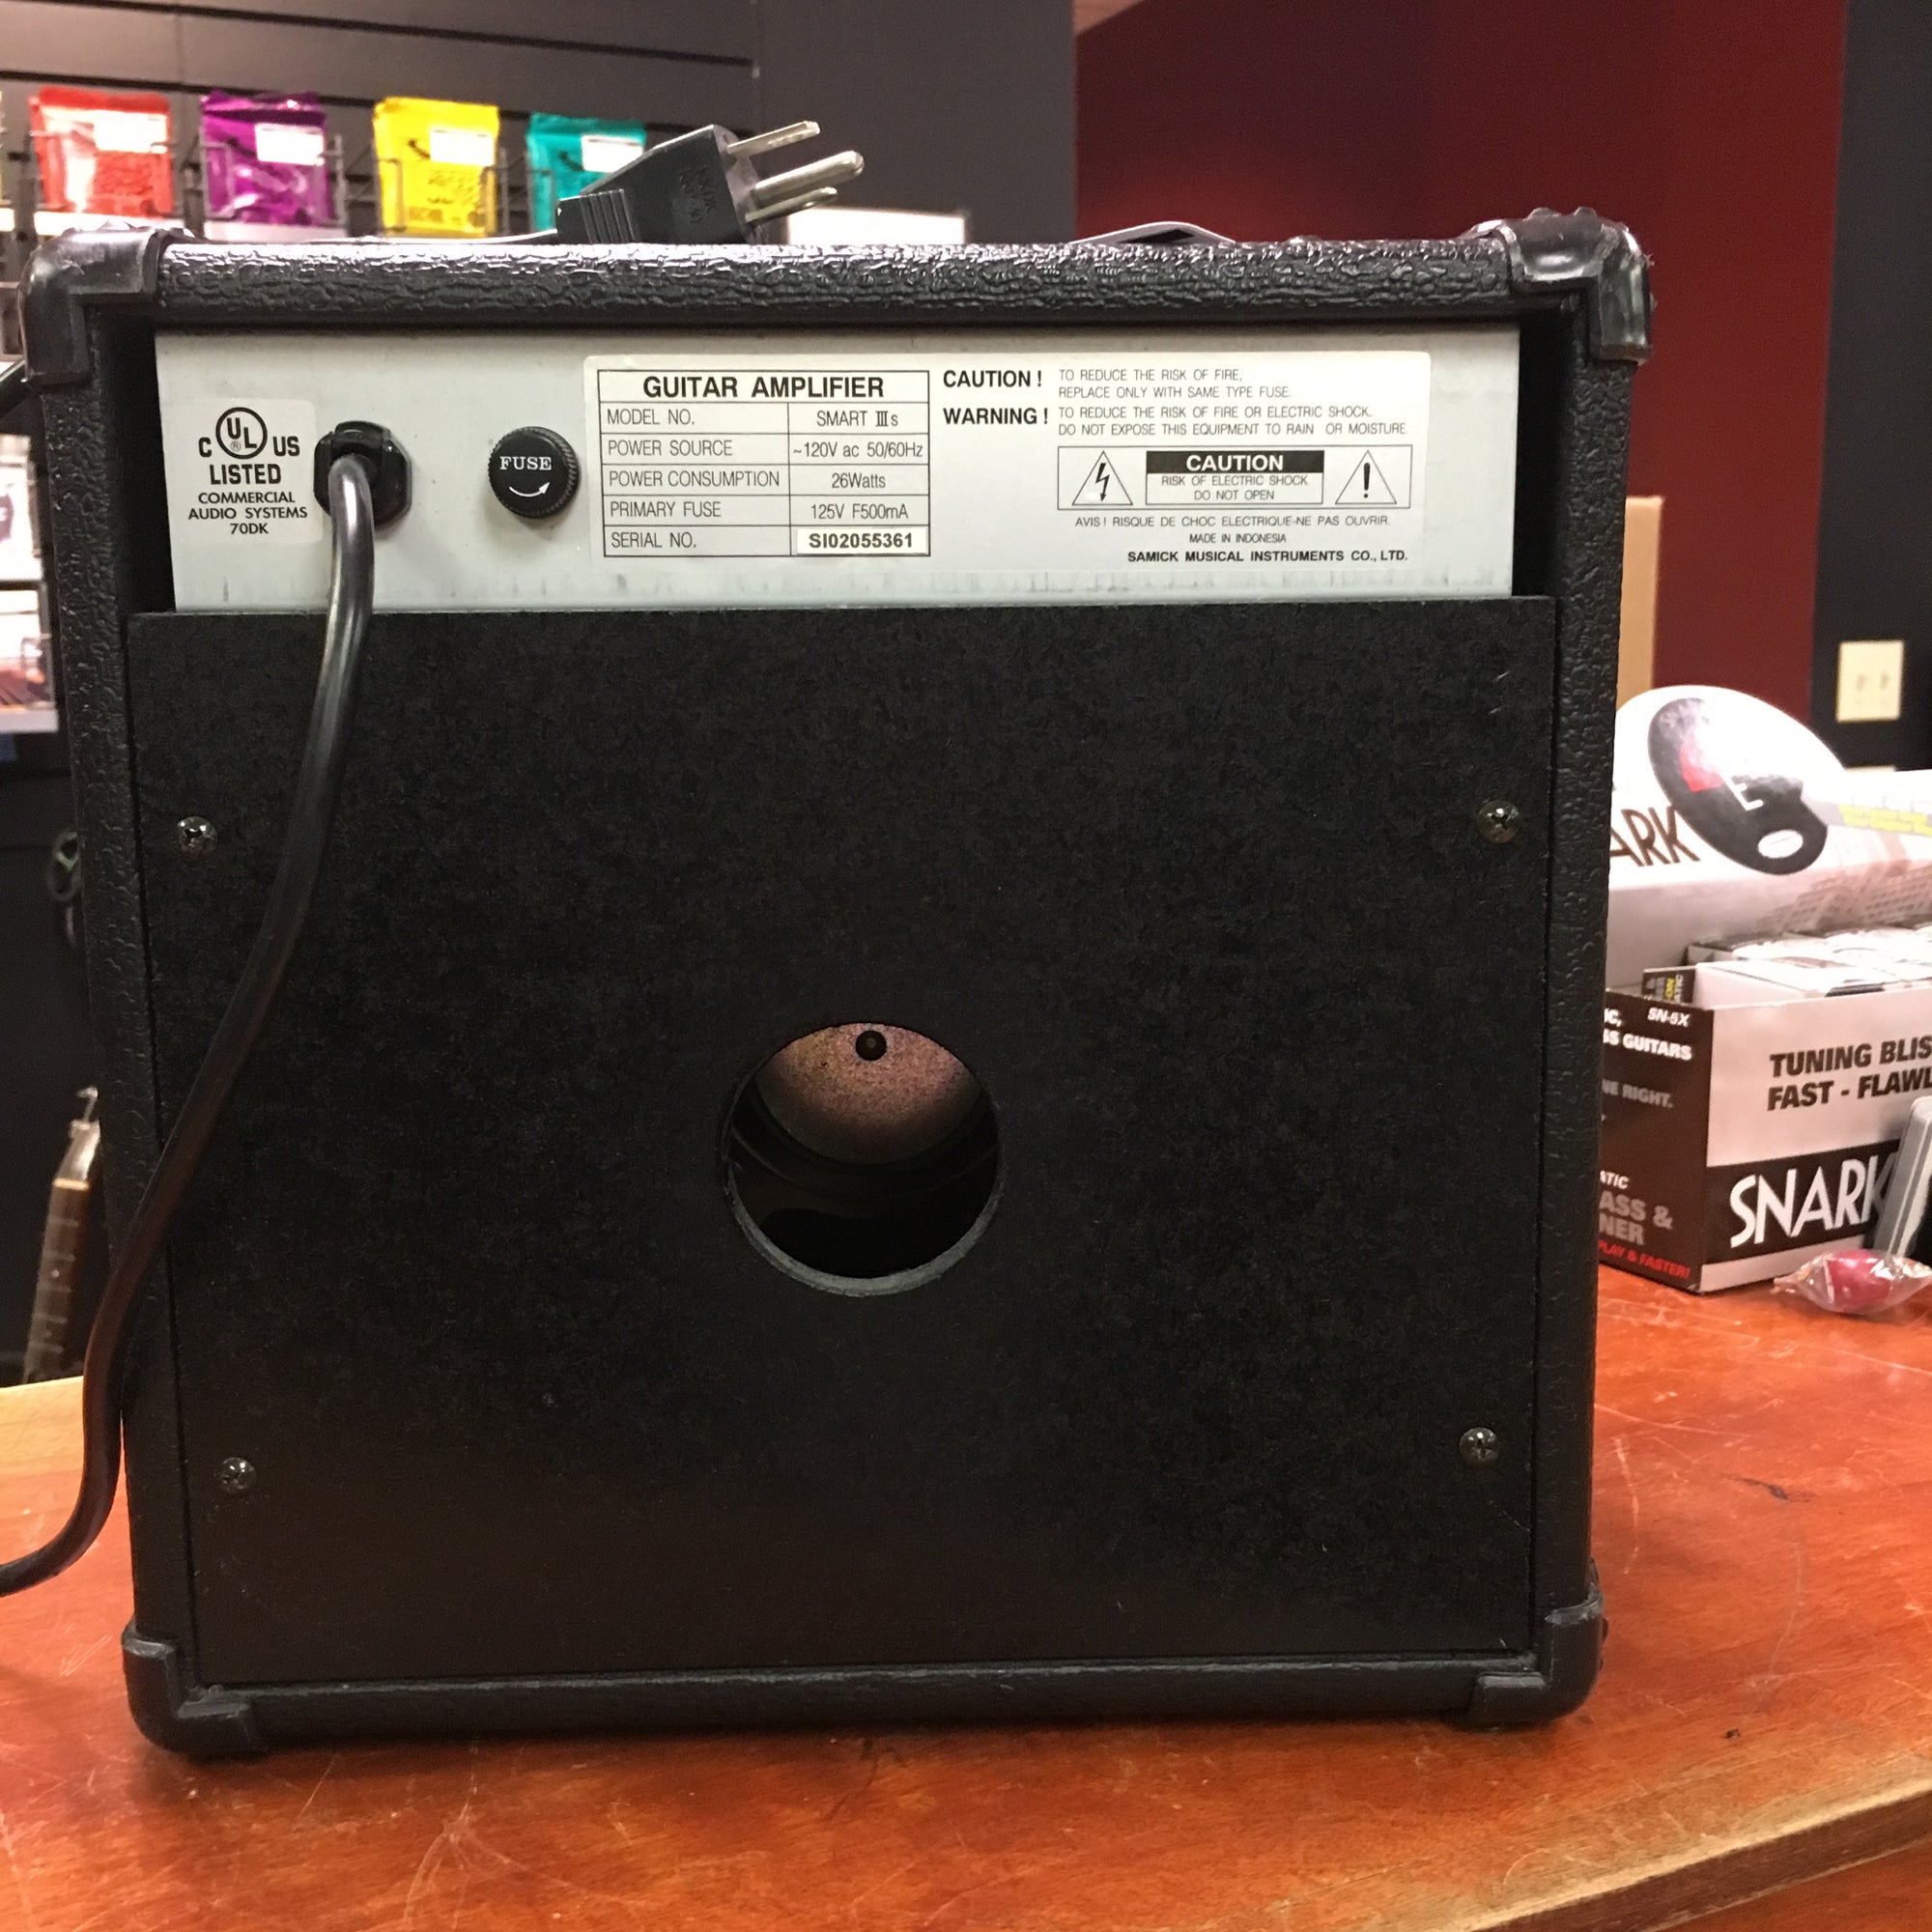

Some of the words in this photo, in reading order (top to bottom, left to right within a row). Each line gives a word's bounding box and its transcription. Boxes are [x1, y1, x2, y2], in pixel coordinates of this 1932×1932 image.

[944, 370, 1031, 387] CAUTION
[1060, 369, 1074, 381] TO
[1081, 369, 1126, 381] REDUCE
[1134, 369, 1154, 381] THE
[1162, 369, 1186, 381] RISK
[1193, 369, 1208, 381] OF
[643, 376, 737, 398] GUITAR
[752, 377, 883, 397] AMPLIFIER
[1059, 386, 1110, 398] REPLACE
[1117, 386, 1148, 398] ONLY
[1153, 386, 1181, 397] WITH
[1188, 386, 1219, 398] SAME
[1226, 386, 1252, 398] TYPE
[1260, 386, 1291, 398] FUSE.
[608, 409, 660, 425] MODEL
[668, 409, 695, 425] NO.
[817, 411, 867, 426] SMART
[943, 408, 1037, 424] WARNING
[1059, 407, 1074, 418] TO
[1080, 407, 1126, 418] REDUCE
[1133, 407, 1154, 418] THE
[1161, 407, 1186, 418] RISK
[1193, 407, 1208, 418] OF
[1214, 406, 1238, 418] FIRE
[1244, 406, 1262, 418] OR
[1267, 406, 1321, 418] ELECTRIC
[1329, 406, 1372, 417] SHOCK.
[1059, 424, 1076, 436] DO
[1082, 424, 1105, 436] NOT
[1112, 424, 1155, 436] EXPOSE
[1162, 423, 1186, 436] THIS
[1193, 423, 1259, 435] EQUIPMENT
[1265, 423, 1281, 435] TO
[1287, 423, 1314, 435] RAIN
[1325, 422, 1342, 435] OR
[1349, 422, 1408, 435] MOISTURE.
[199, 438, 212, 457] C
[272, 436, 299, 456] US
[609, 440, 662, 456] POWER
[669, 440, 732, 456] SOURCE
[843, 445, 859, 457] ac
[867, 441, 923, 459] 50/60Hz
[499, 456, 553, 470] FUSE
[1186, 455, 1284, 471] CAUTION
[210, 464, 281, 485] LISTED
[610, 470, 663, 487] POWER
[668, 470, 779, 487] CONSUMPTION
[832, 472, 886, 488] 26Watts
[1161, 475, 1185, 486] RISK
[1191, 475, 1207, 486] OF
[1211, 475, 1264, 486] ELECTRIC
[1269, 475, 1308, 486] SHOCK
[198, 492, 295, 504] COMMERCIAL
[1194, 490, 1210, 500] DO
[1216, 490, 1238, 500] NOT
[1244, 490, 1274, 500] OPEN
[188, 507, 237, 520] AUDIO
[245, 507, 307, 519] SYSTEMS
[611, 501, 675, 517] PRIMARY
[683, 501, 721, 518] FUSE
[811, 503, 844, 519] 125V
[853, 503, 908, 519] F500mA
[230, 523, 269, 534] 70DK
[1113, 517, 1153, 526] RISQUE
[1160, 517, 1175, 526] DE
[1181, 516, 1215, 526] CHOC
[1318, 516, 1339, 526] PAS
[611, 532, 663, 548] SERIAL
[670, 532, 697, 548] NO.
[1189, 533, 1215, 543] MADE
[1222, 534, 1231, 543] IN
[1236, 533, 1287, 543] INDONESIA
[1128, 552, 1179, 562] SAMICK
[1185, 552, 1244, 561] MUSICAL
[1251, 551, 1344, 561] INSTRUMENTS
[1622, 1033, 1692, 1061] GUITARS
[1769, 1043, 1872, 1077] TUNING
[1622, 1083, 1674, 1108] RIGHT.
[1767, 1080, 1834, 1111] FAST
[1729, 1150, 1899, 1249] SNARK
[1653, 1205, 1673, 1230] &
